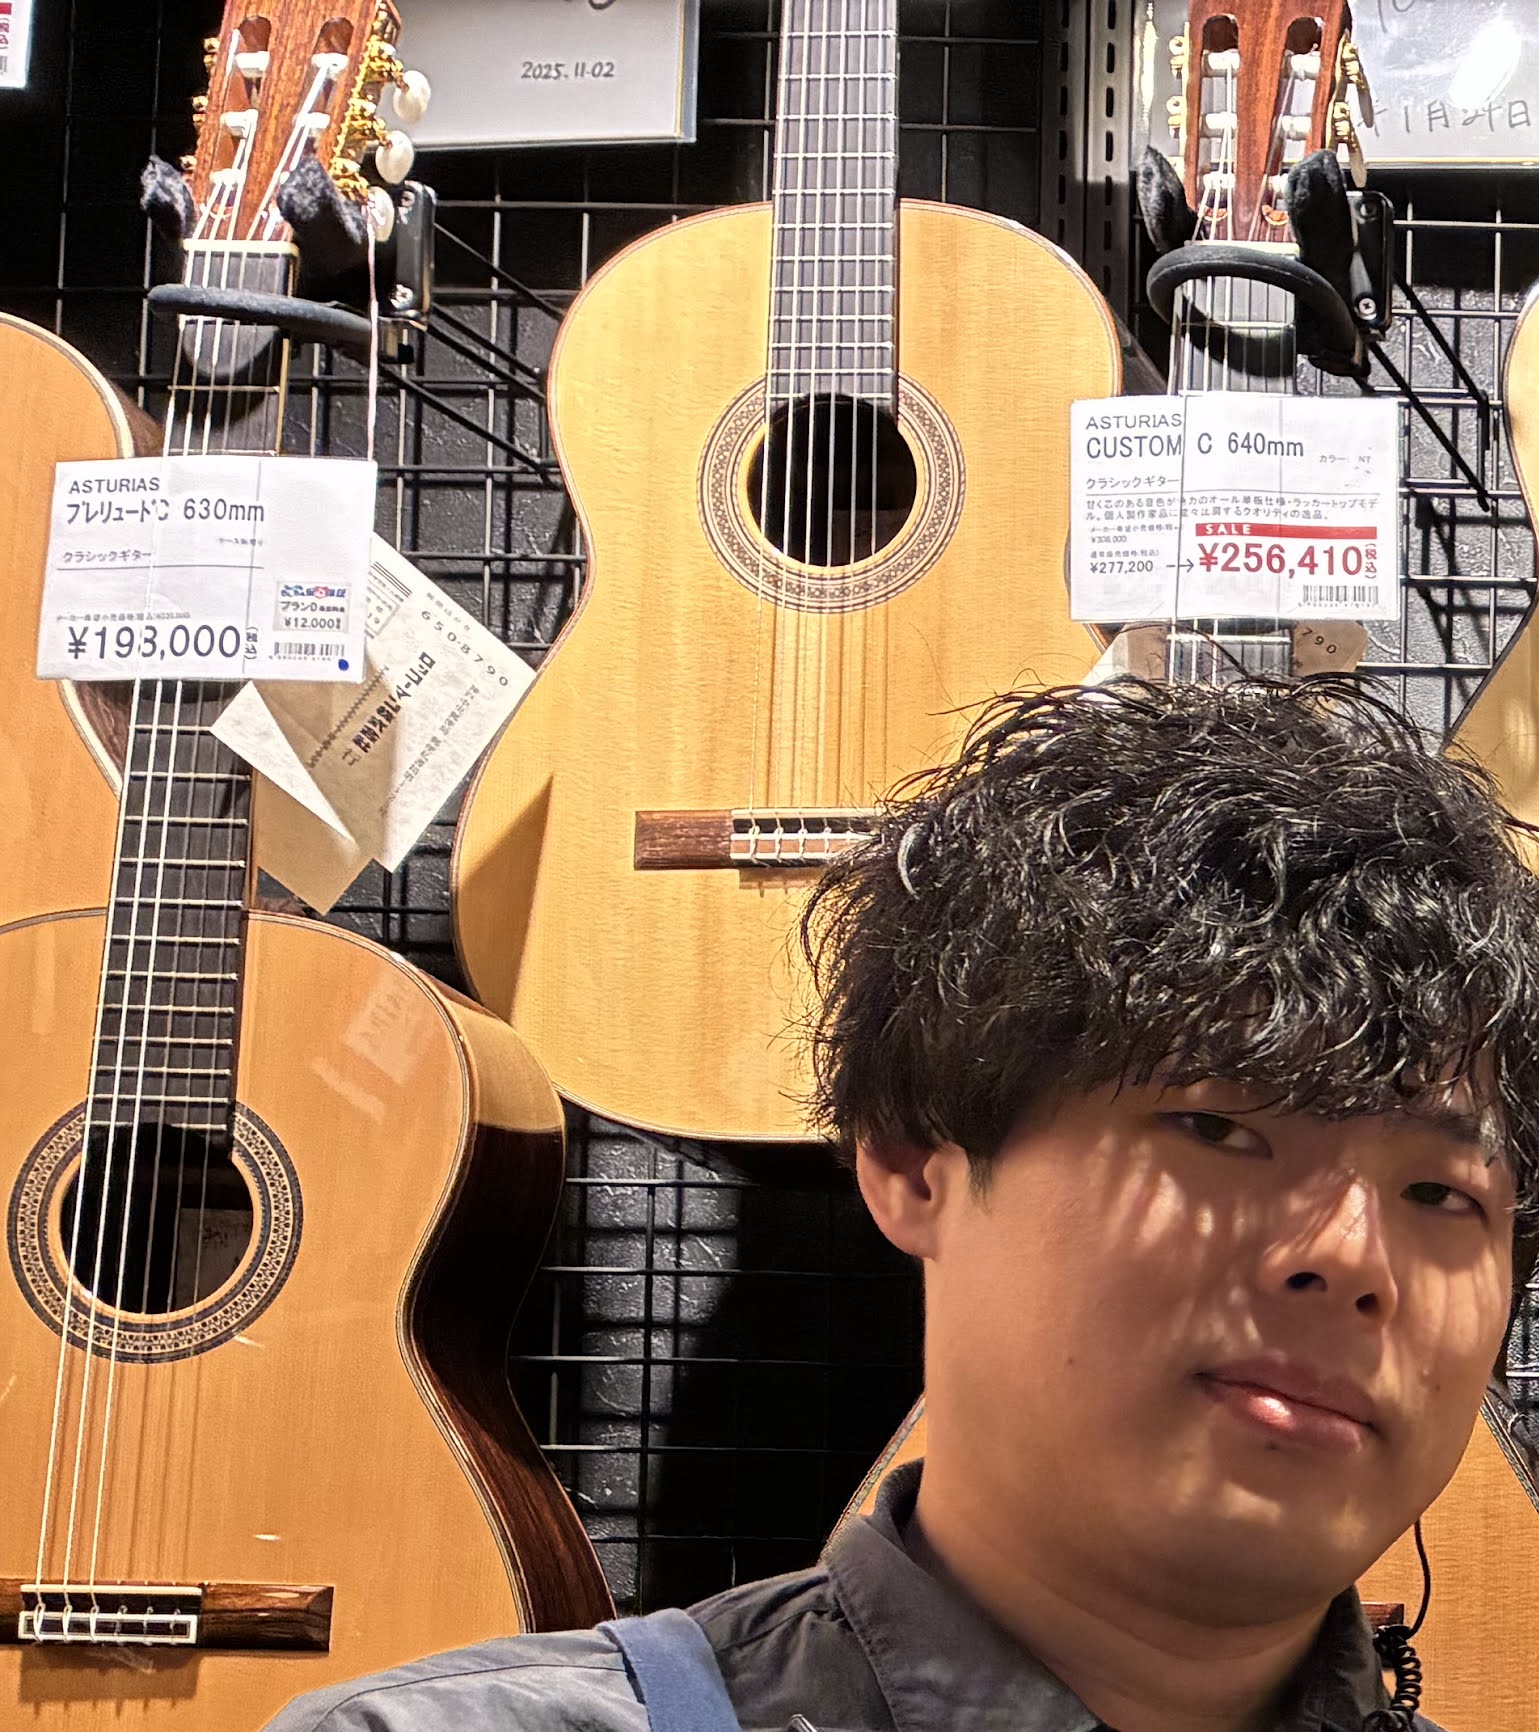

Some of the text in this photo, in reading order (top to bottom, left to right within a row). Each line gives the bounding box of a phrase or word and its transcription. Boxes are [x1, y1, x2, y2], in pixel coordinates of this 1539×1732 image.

[1086, 413, 1182, 430] ASTURIAS
[1086, 432, 1304, 459] CUSTOM C 640mm
[68, 477, 160, 494] ASTURIAS
[1086, 476, 1179, 490] クラシックギター
[184, 498, 265, 522] 630mm
[1205, 524, 1251, 535] SALE
[62, 550, 152, 563] クラシックギター
[1198, 542, 1363, 579] ¥256,410
[1090, 560, 1154, 575] ¥277,200
